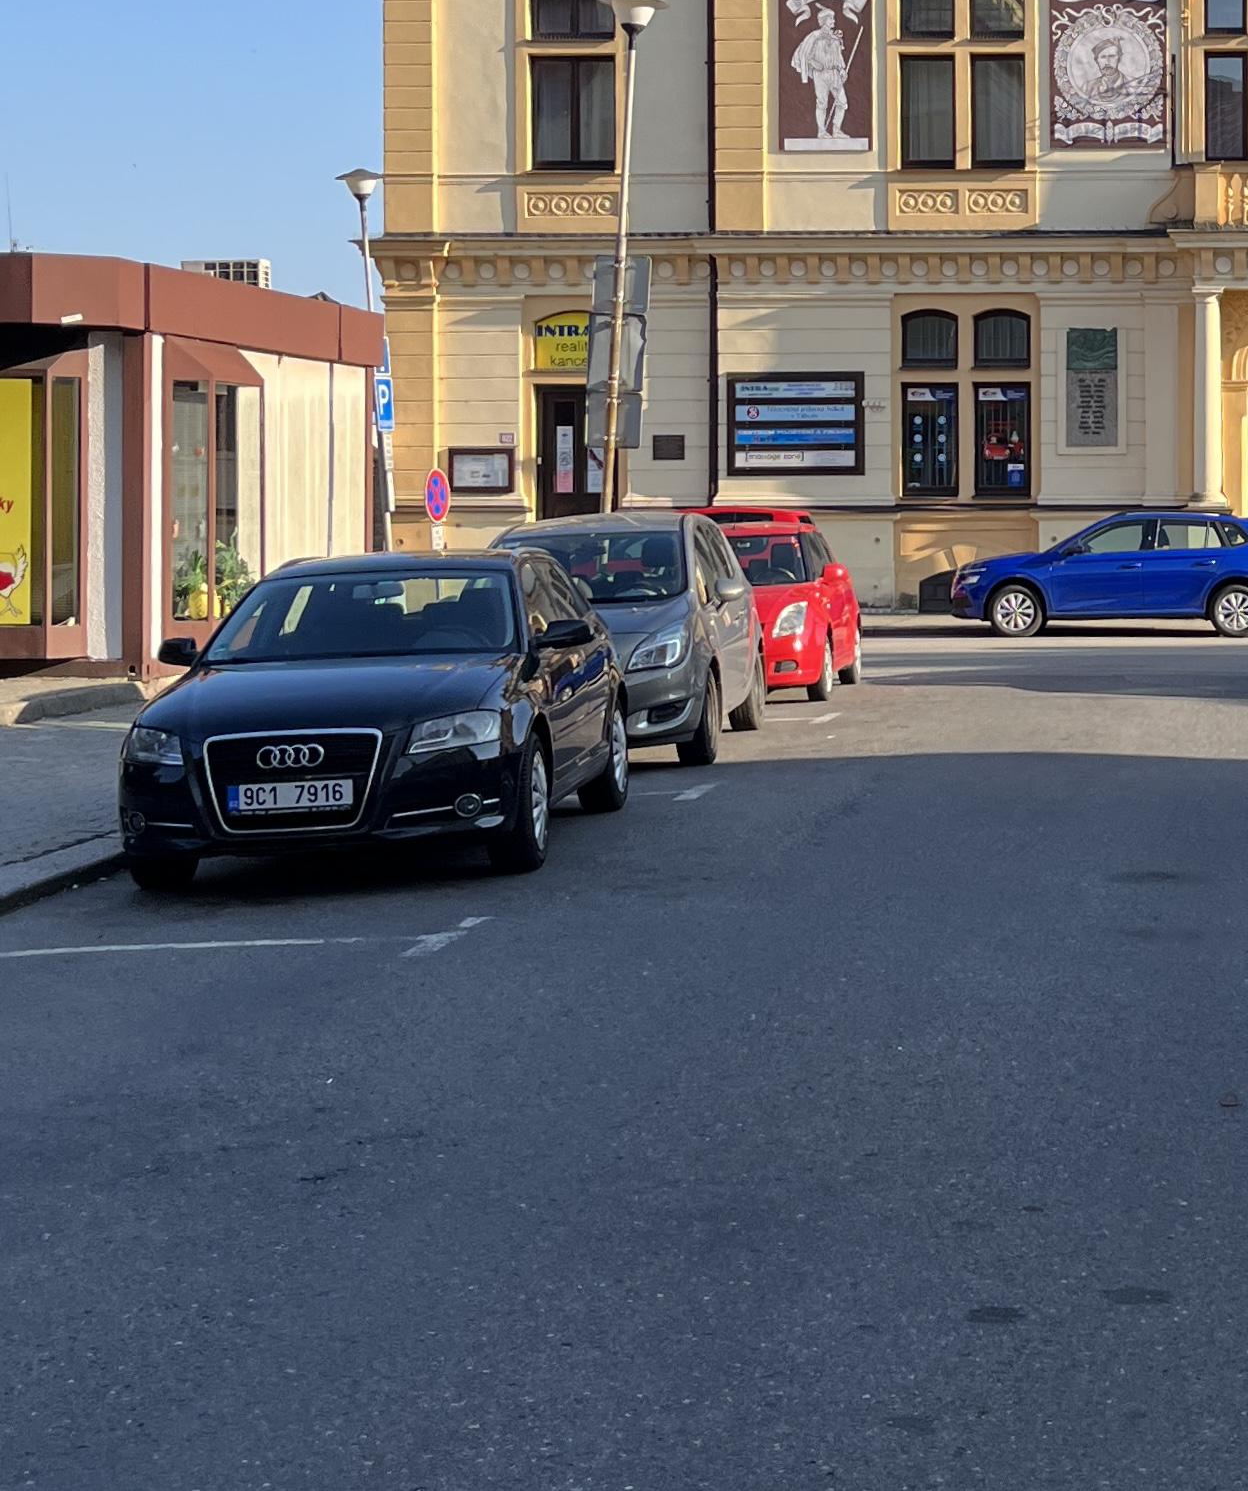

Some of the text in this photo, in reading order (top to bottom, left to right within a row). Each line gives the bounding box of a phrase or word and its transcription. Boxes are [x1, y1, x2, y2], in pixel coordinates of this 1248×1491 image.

[378, 383, 389, 416] P
[243, 787, 279, 807] 9C1
[293, 783, 344, 805] 7916
